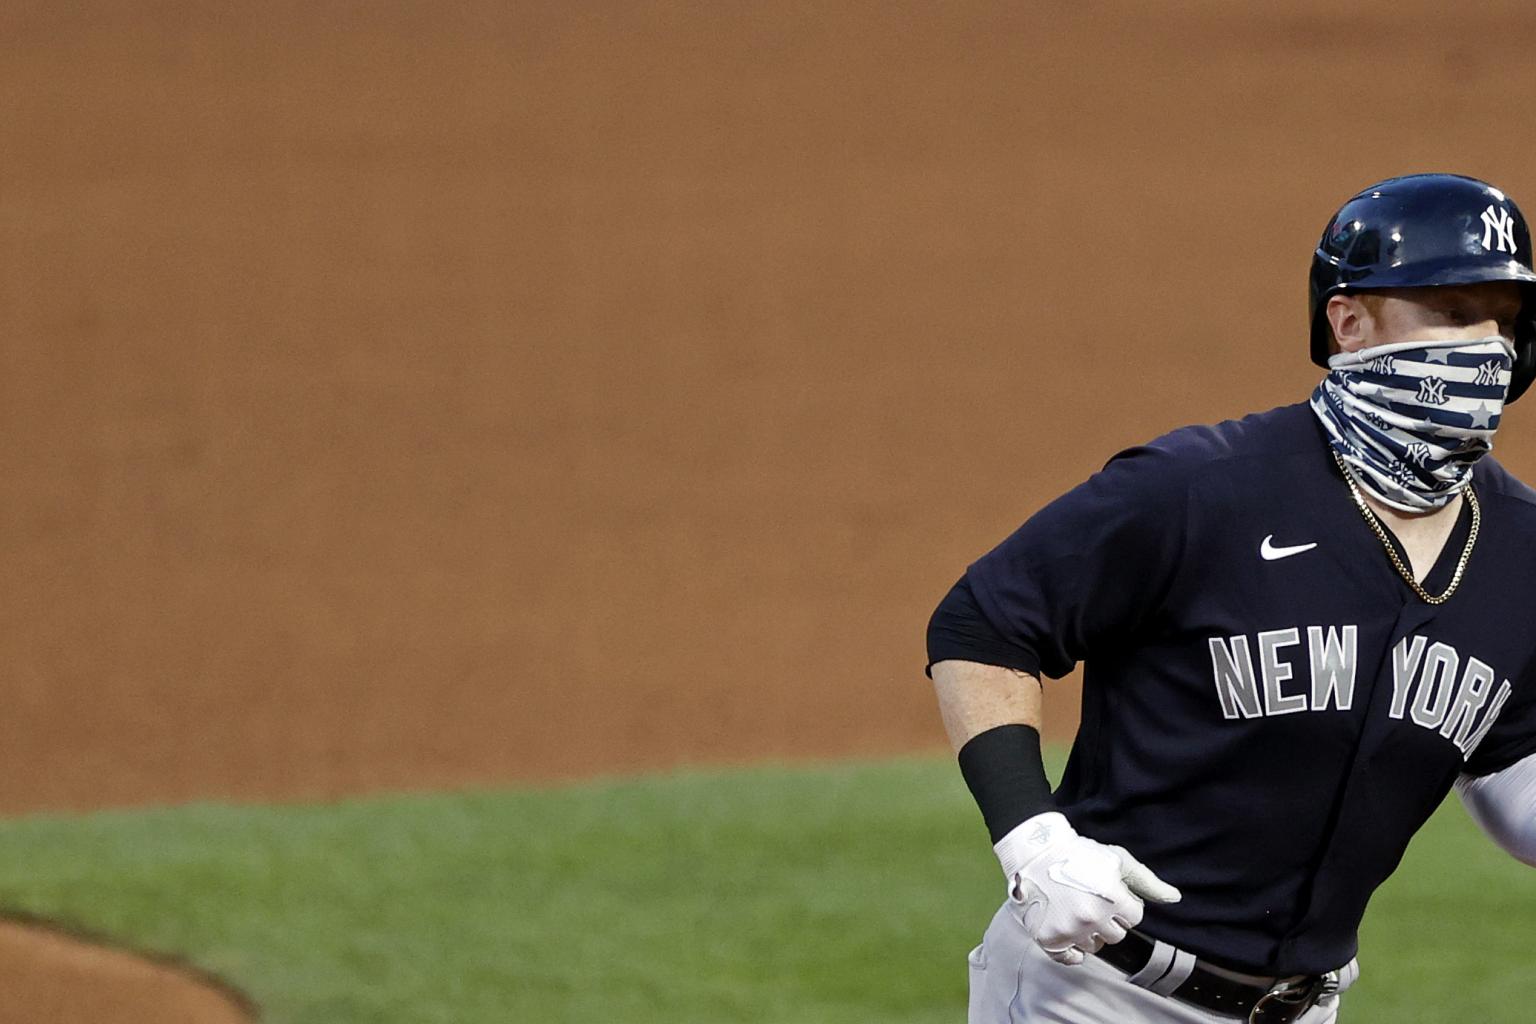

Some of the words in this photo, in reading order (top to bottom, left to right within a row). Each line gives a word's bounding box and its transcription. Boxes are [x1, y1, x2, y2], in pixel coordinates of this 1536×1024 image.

[1480, 204, 1518, 255] NY
[1416, 376, 1450, 405] NY
[1208, 625, 1357, 719] NEW
